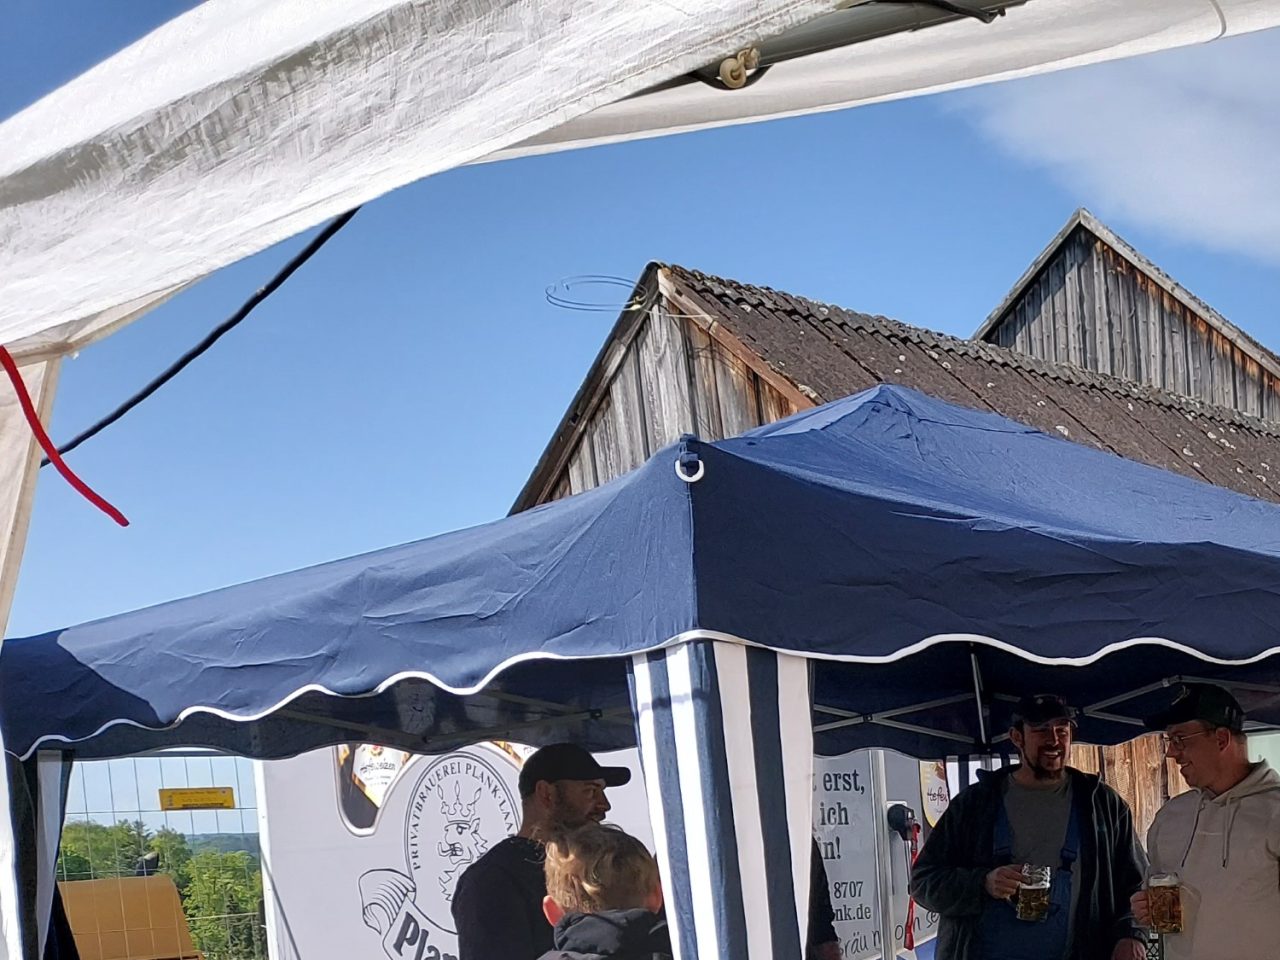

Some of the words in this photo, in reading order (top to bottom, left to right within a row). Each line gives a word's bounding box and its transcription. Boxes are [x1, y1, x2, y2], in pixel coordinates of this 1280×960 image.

[822, 769, 865, 795] erst,
[410, 761, 461, 870] PRIVATBRAUEREI
[820, 802, 849, 826] ich
[833, 881, 864, 899] 8707
